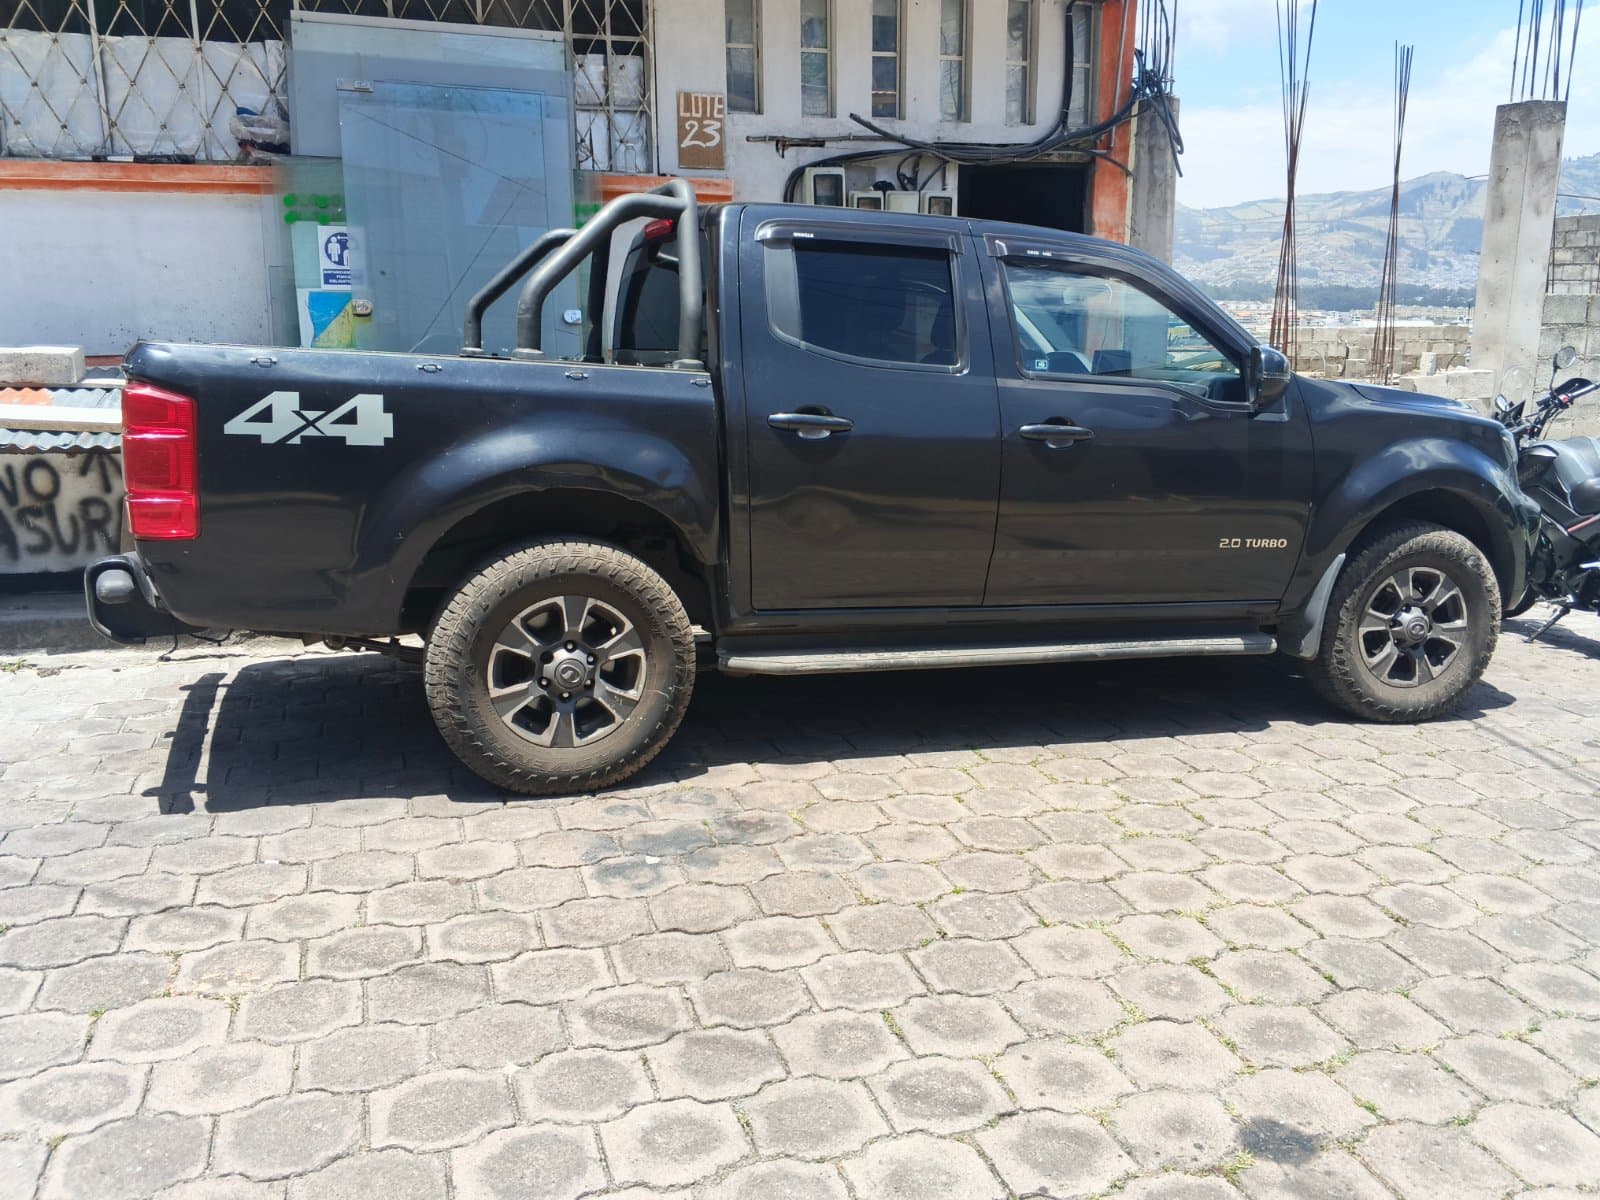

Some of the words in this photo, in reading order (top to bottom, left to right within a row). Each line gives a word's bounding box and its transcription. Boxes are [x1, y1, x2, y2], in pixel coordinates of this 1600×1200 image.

[679, 92, 724, 118] LOTE
[680, 120, 722, 148] 23
[1245, 538, 1288, 548] TURBO
